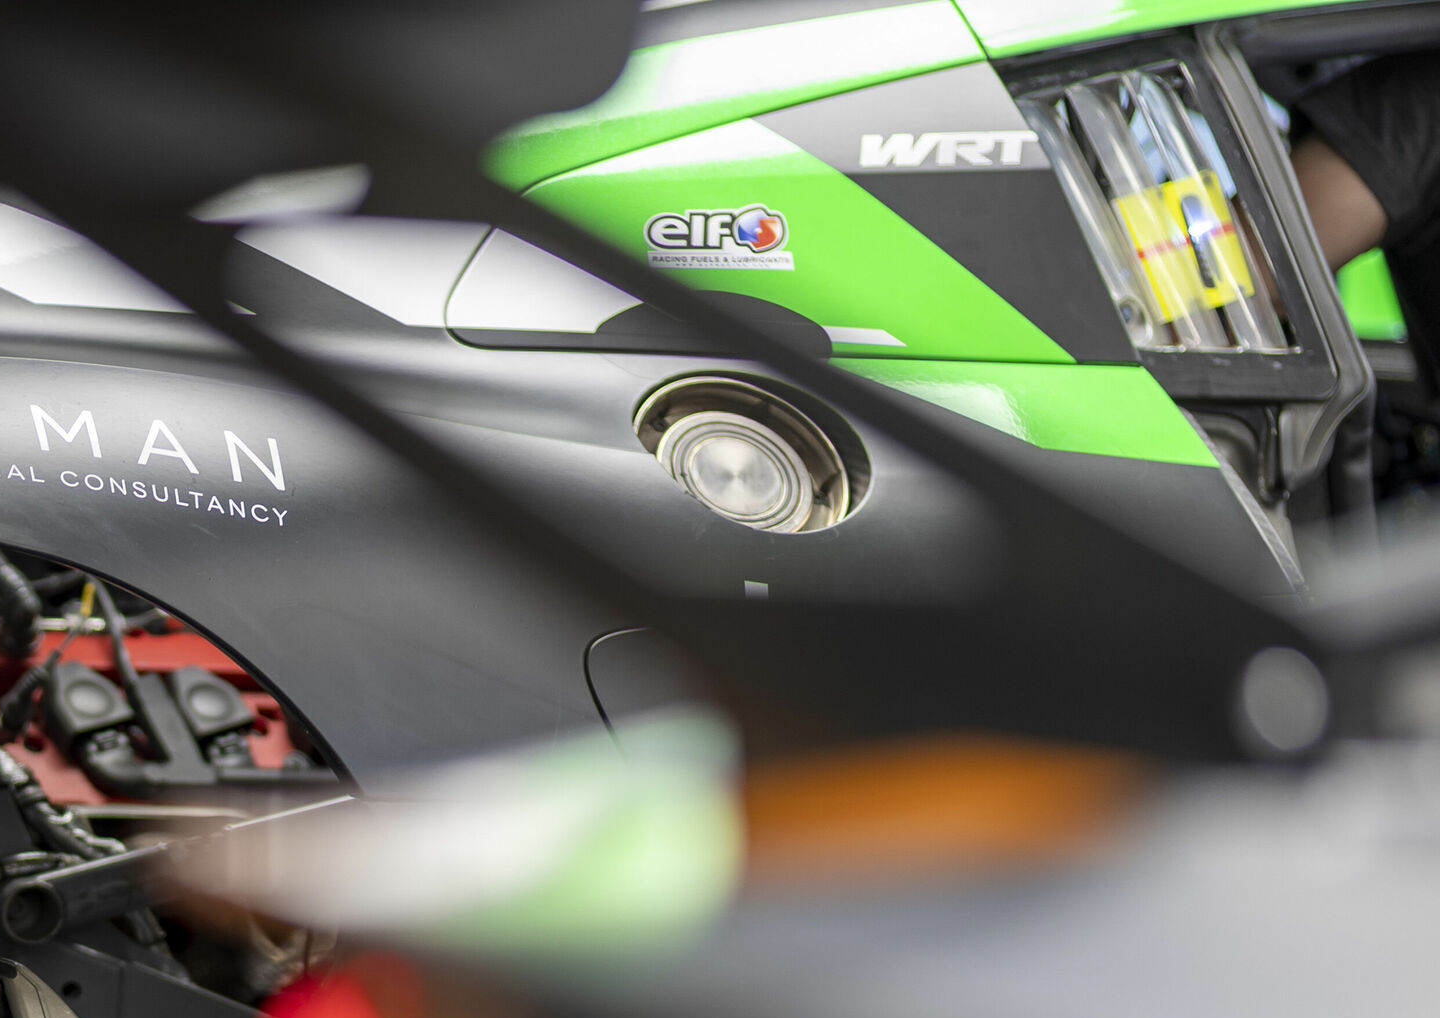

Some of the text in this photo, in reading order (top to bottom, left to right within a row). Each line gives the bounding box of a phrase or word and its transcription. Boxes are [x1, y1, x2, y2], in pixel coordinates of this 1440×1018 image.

[859, 131, 1039, 166] WRT
[649, 211, 734, 249] elf
[652, 255, 688, 263] RACING
[690, 255, 719, 263] FUELS
[60, 470, 289, 527] CONSULTANCY
